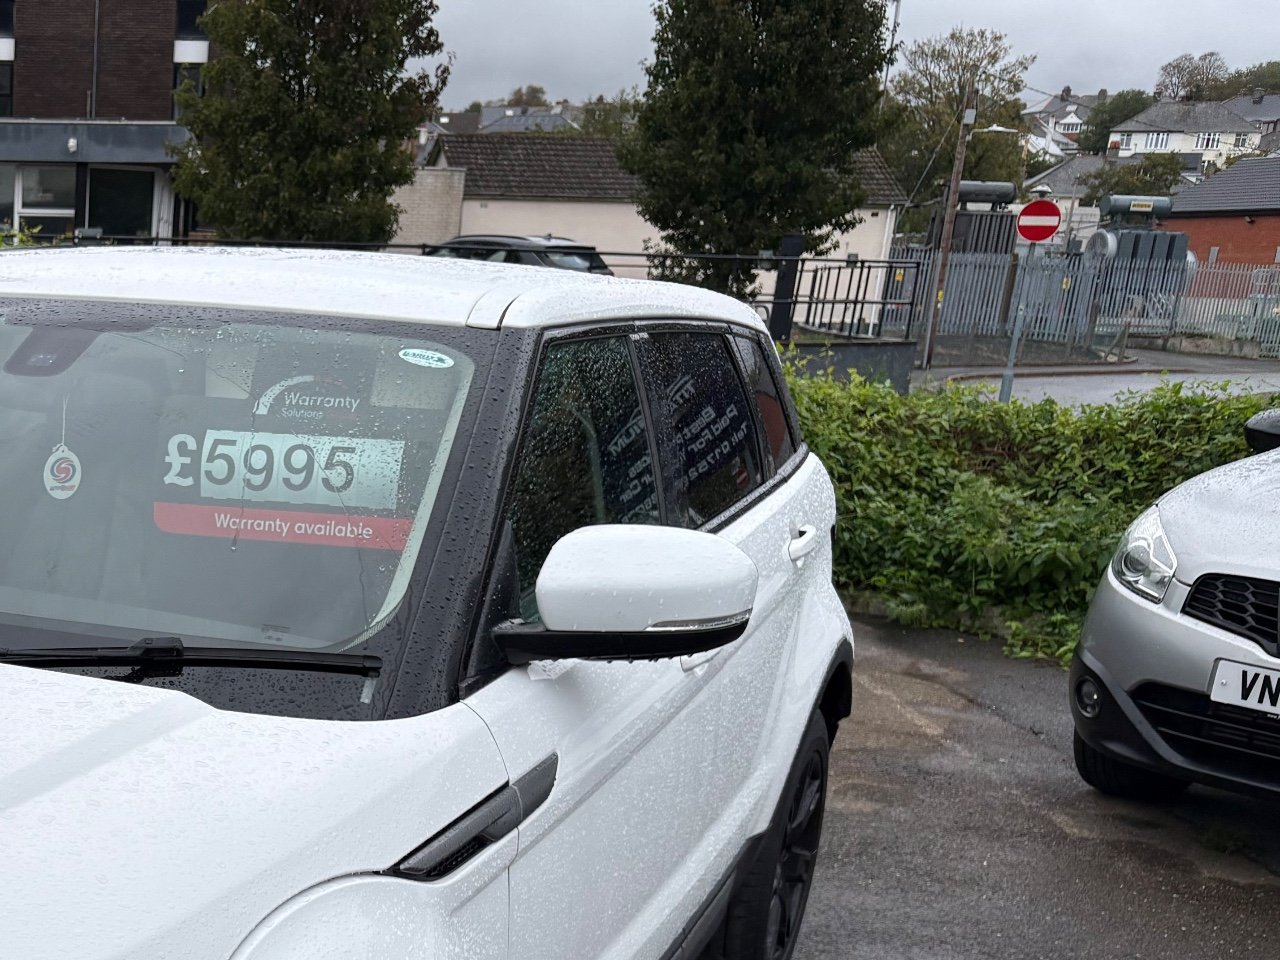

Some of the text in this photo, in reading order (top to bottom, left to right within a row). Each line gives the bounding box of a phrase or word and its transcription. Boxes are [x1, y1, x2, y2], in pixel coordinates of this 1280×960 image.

[285, 391, 360, 413] Warranty
[163, 432, 356, 493] £5995
[214, 512, 373, 539] Warranty available
[1241, 669, 1280, 707] VN
